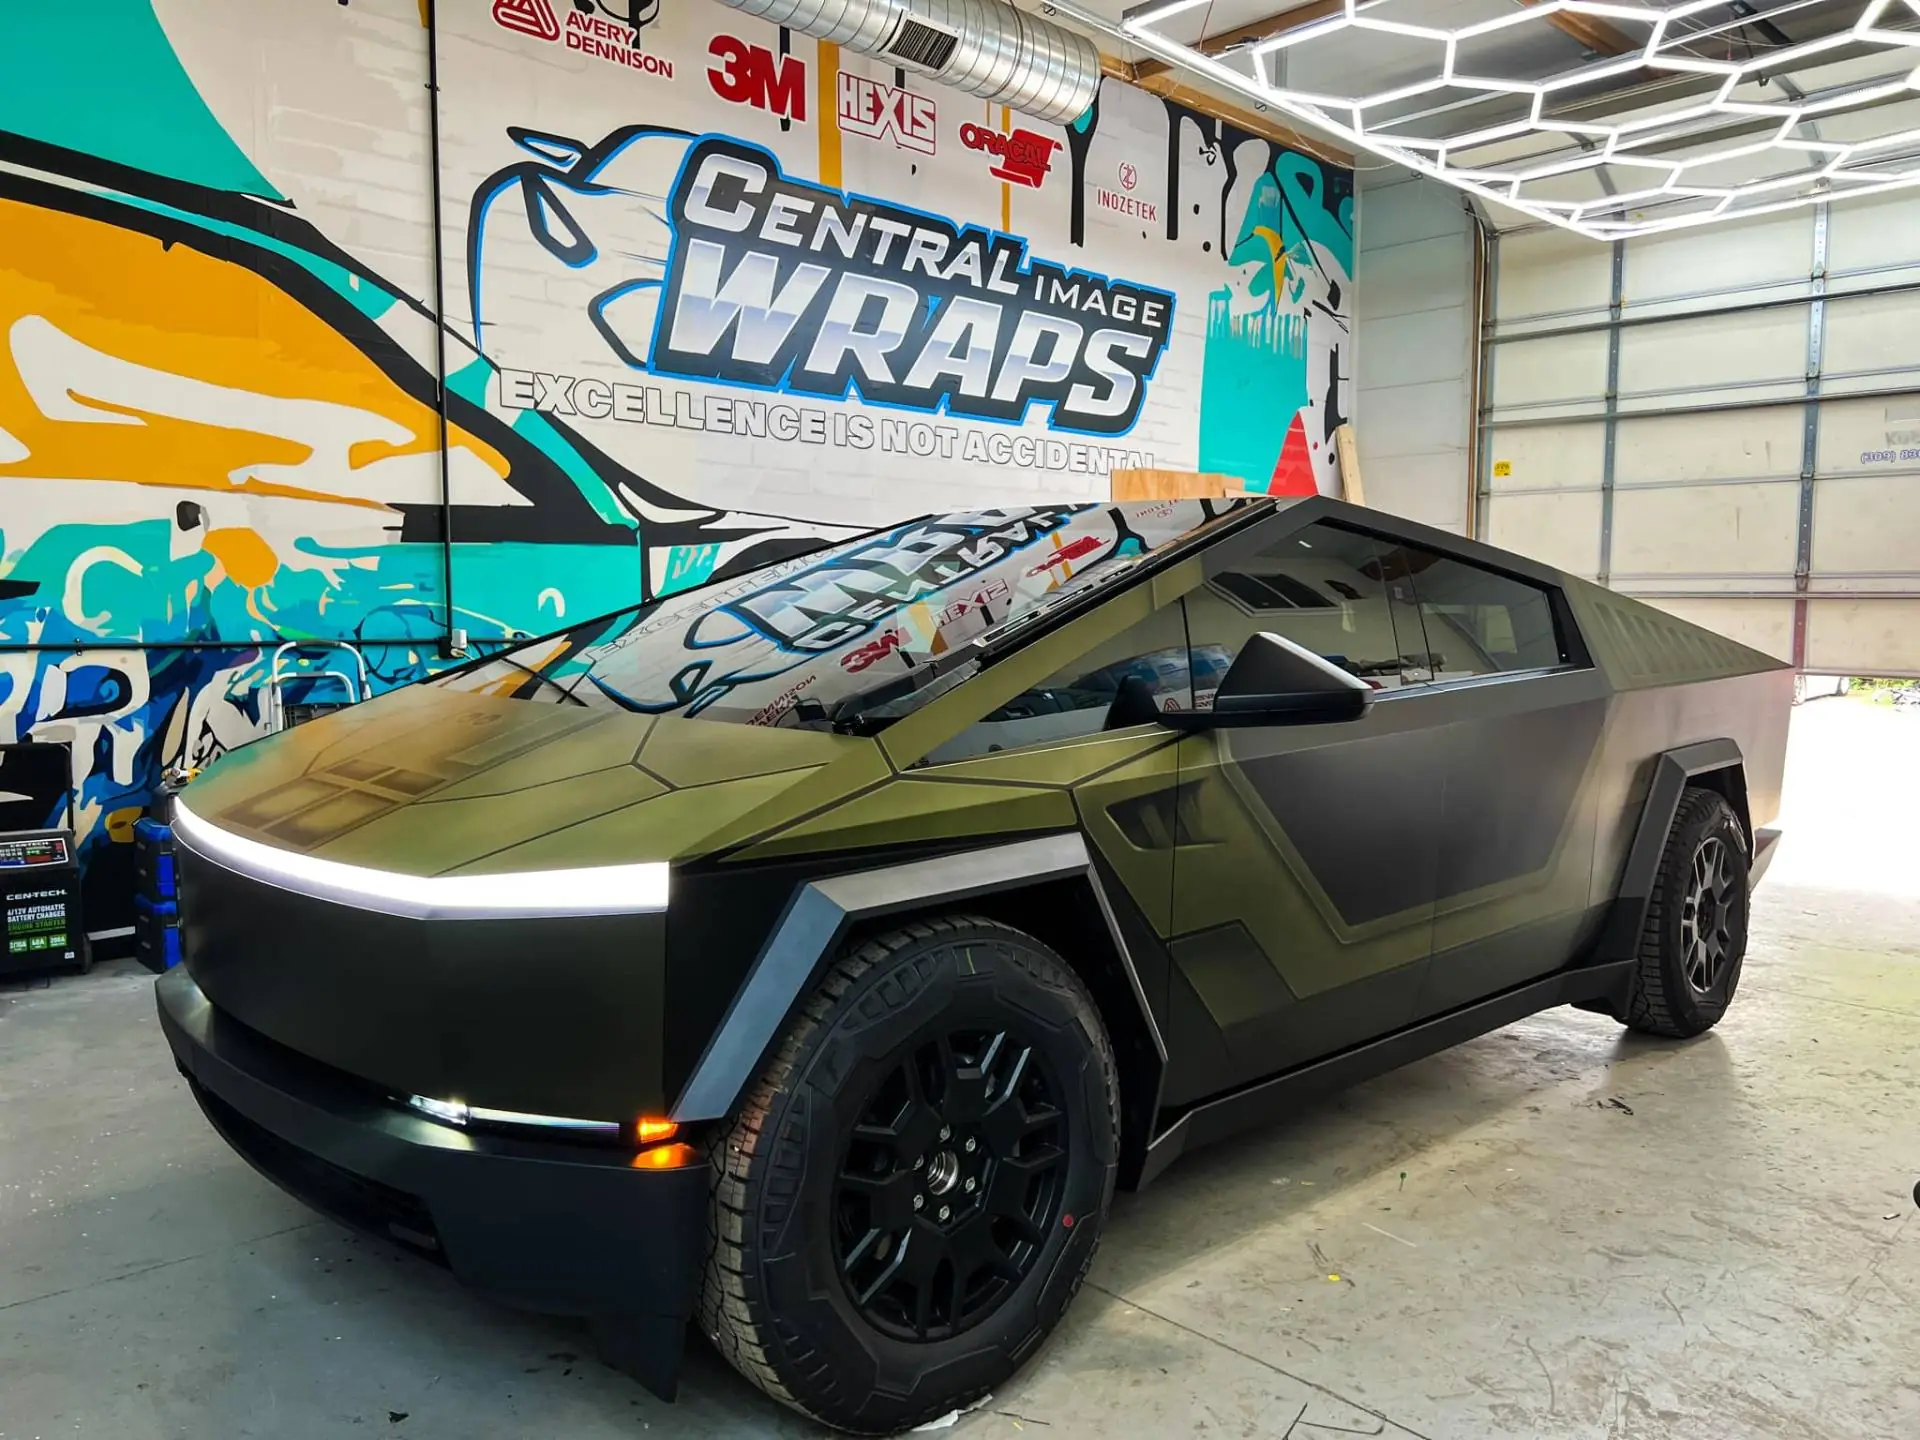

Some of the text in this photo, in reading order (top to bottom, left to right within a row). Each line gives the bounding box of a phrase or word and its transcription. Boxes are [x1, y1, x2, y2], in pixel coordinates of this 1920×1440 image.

[565, 32, 673, 79] DENNISON
[566, 13, 635, 45] AVERY
[707, 34, 806, 122] 3M
[838, 71, 936, 156] HEXIS
[959, 122, 1051, 172] ORACAL
[682, 152, 1165, 330] CENTRAL IMAGE
[1097, 188, 1157, 222] INOZETEK
[666, 238, 1153, 418] WRAPS
[499, 367, 826, 444] EXCELLENCE
[833, 413, 875, 449] IS
[881, 418, 958, 458] NOT
